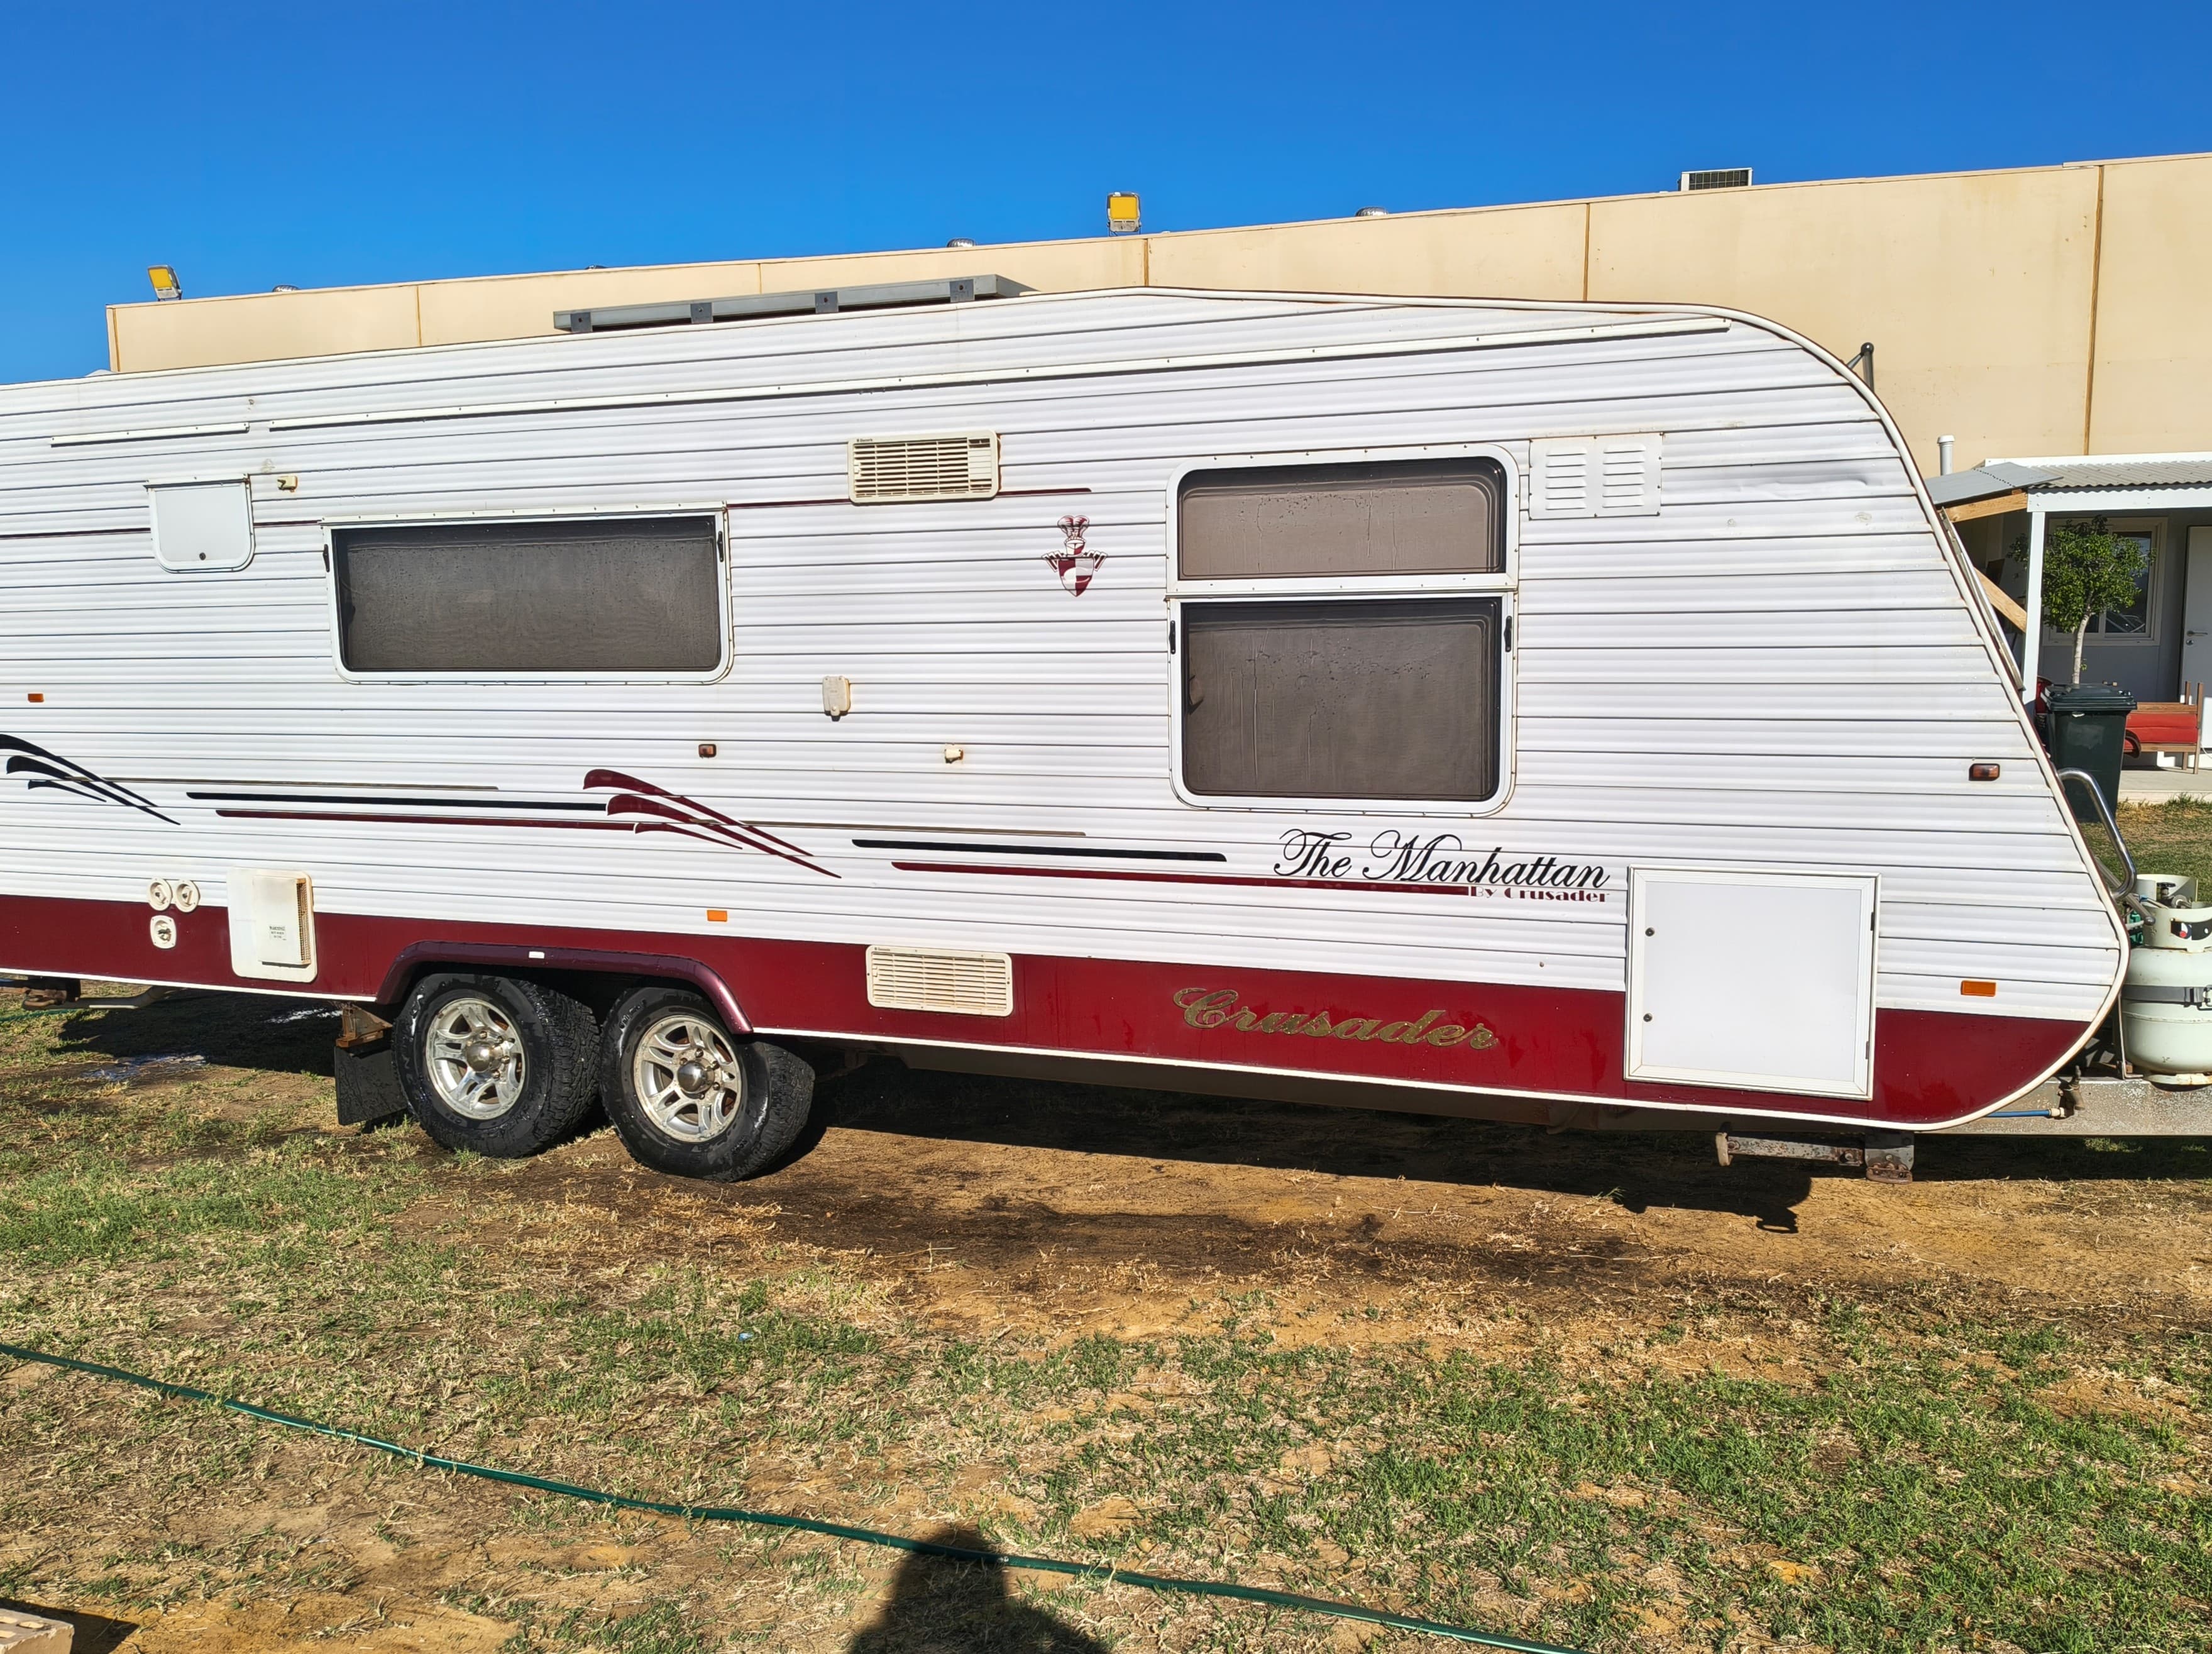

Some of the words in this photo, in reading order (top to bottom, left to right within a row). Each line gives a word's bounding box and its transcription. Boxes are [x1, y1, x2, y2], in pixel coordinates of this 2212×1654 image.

[1274, 828, 1353, 877] The
[1362, 829, 1610, 888] Manhattan
[1470, 885, 1497, 898] By
[1504, 887, 1610, 903] Crusader
[1172, 988, 1499, 1050] Crusader
